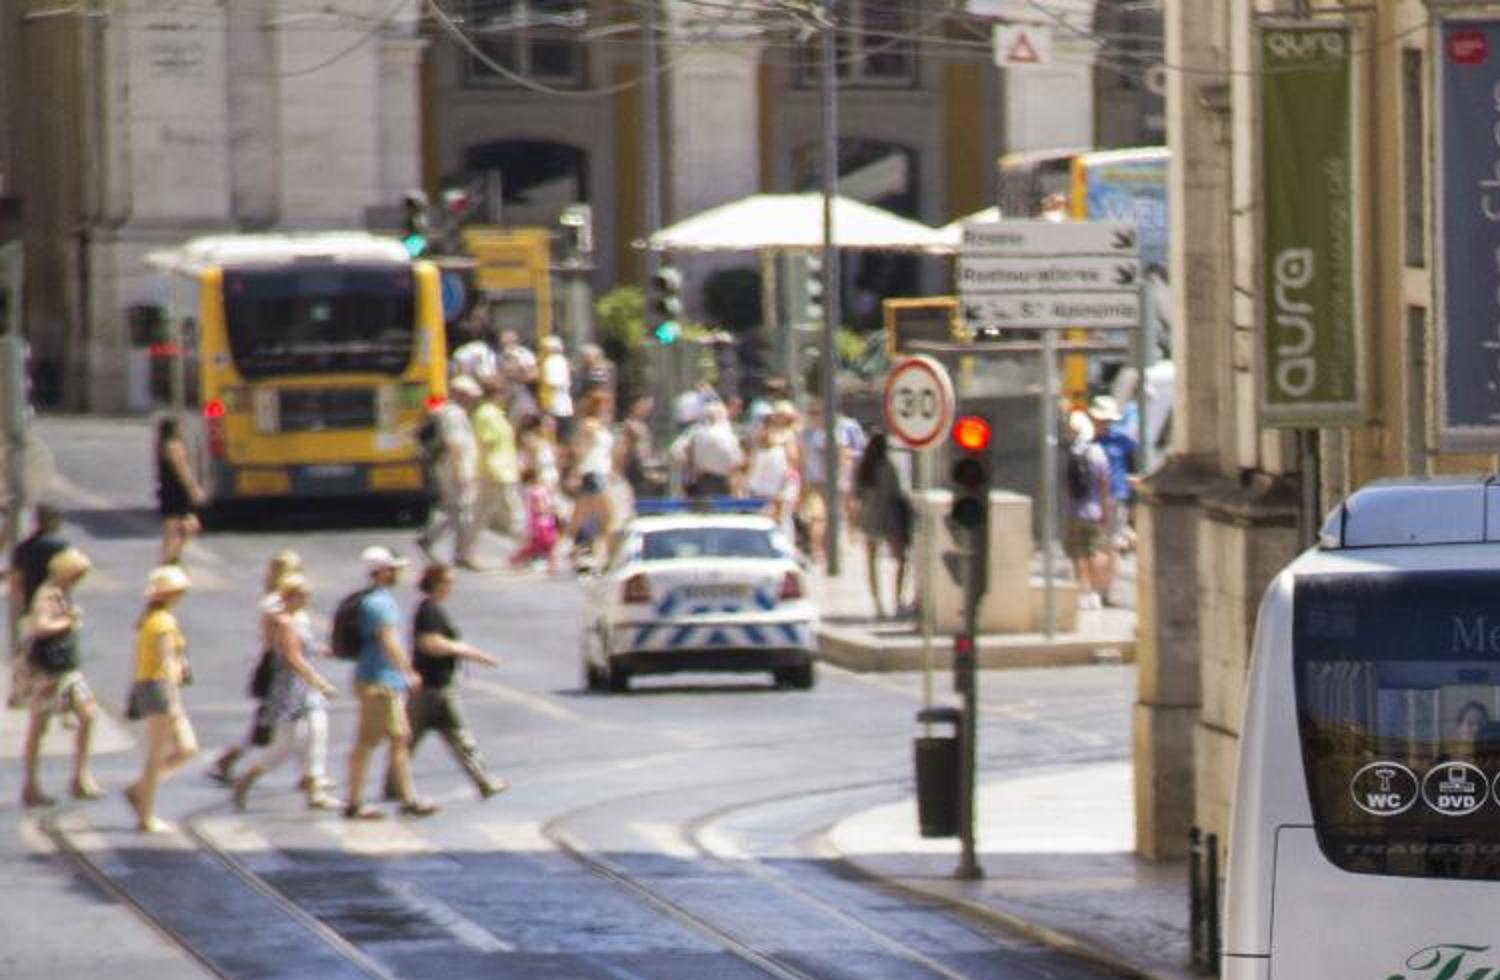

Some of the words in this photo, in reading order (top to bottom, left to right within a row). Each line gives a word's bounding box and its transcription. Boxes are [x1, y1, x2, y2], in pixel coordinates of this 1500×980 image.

[1273, 247, 1317, 397] aura
[899, 387, 936, 419] 30
[1367, 793, 1401, 809] WC
[1437, 795, 1476, 809] DVD
